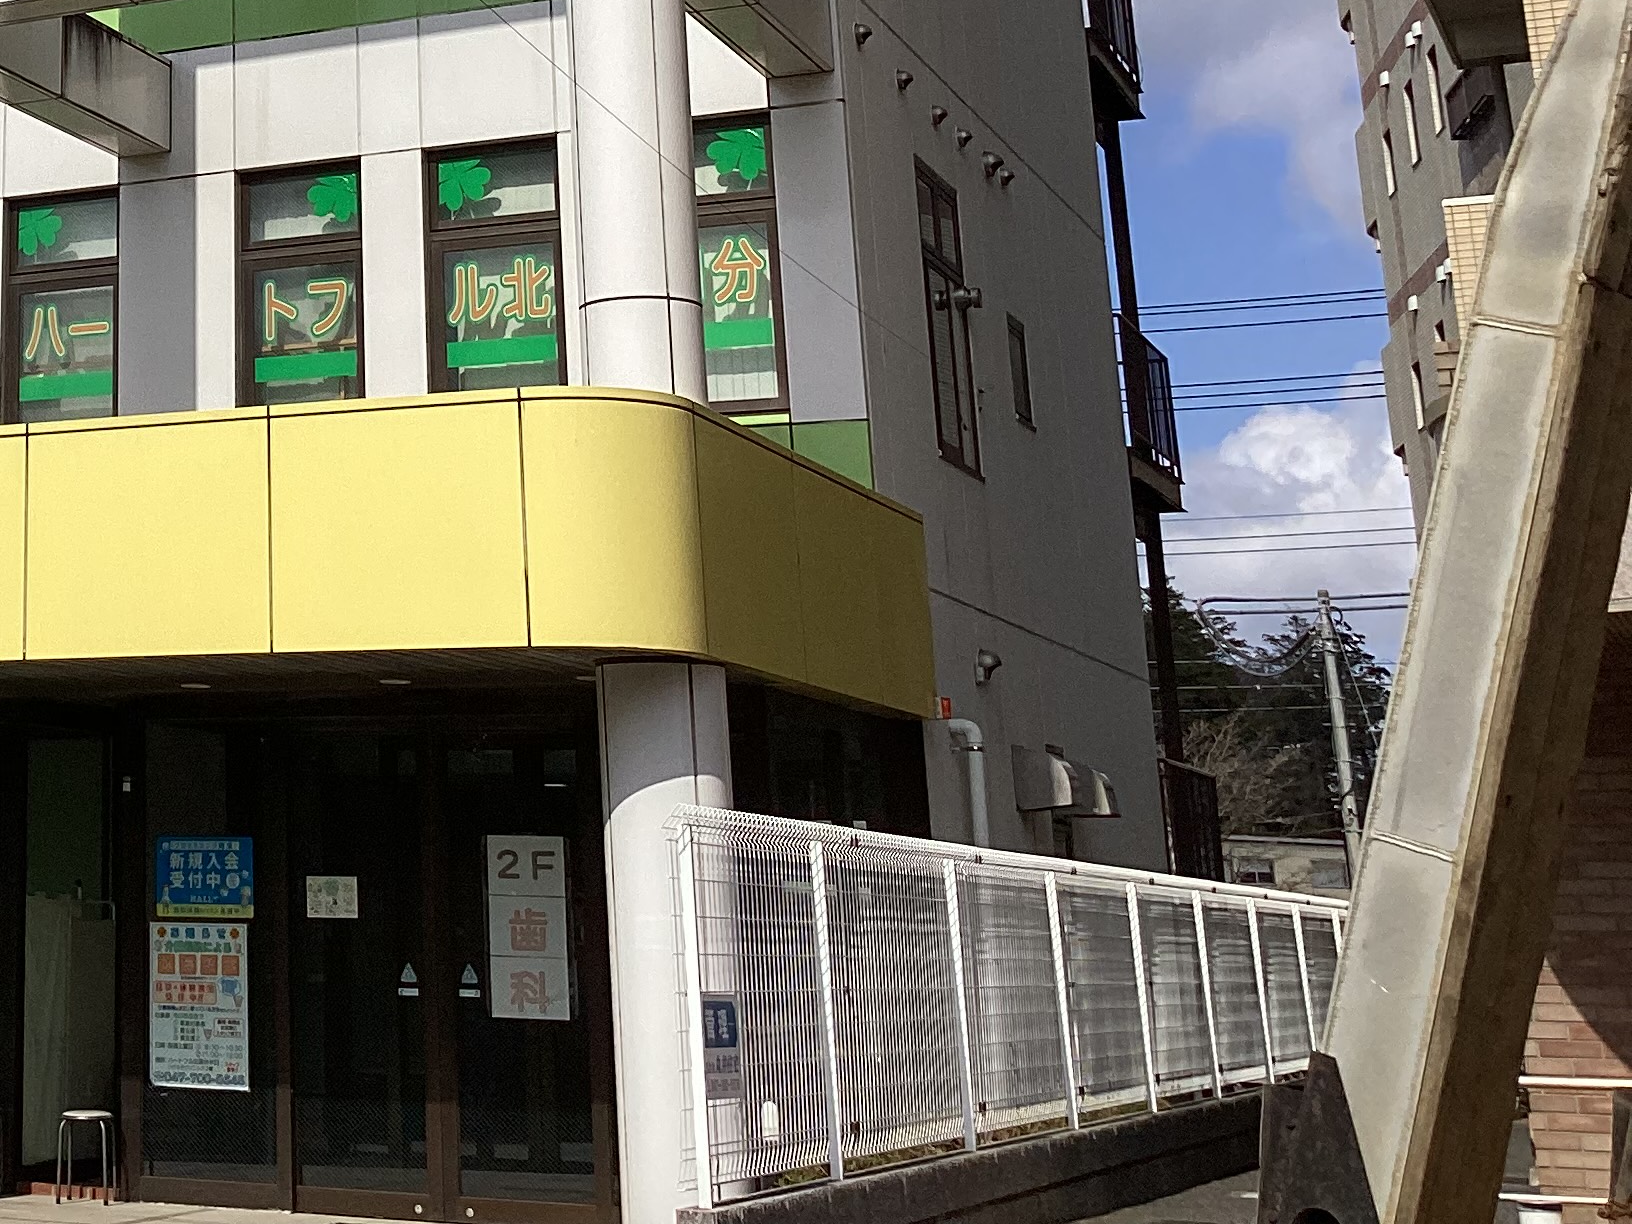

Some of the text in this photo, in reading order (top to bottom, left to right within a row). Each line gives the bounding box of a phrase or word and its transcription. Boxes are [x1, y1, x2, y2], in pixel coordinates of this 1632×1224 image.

[711, 236, 765, 304] 分
[169, 852, 239, 870] 新規入会
[496, 849, 556, 880] 2F
[169, 871, 221, 889] 受付中
[509, 908, 550, 1014] 歯科
